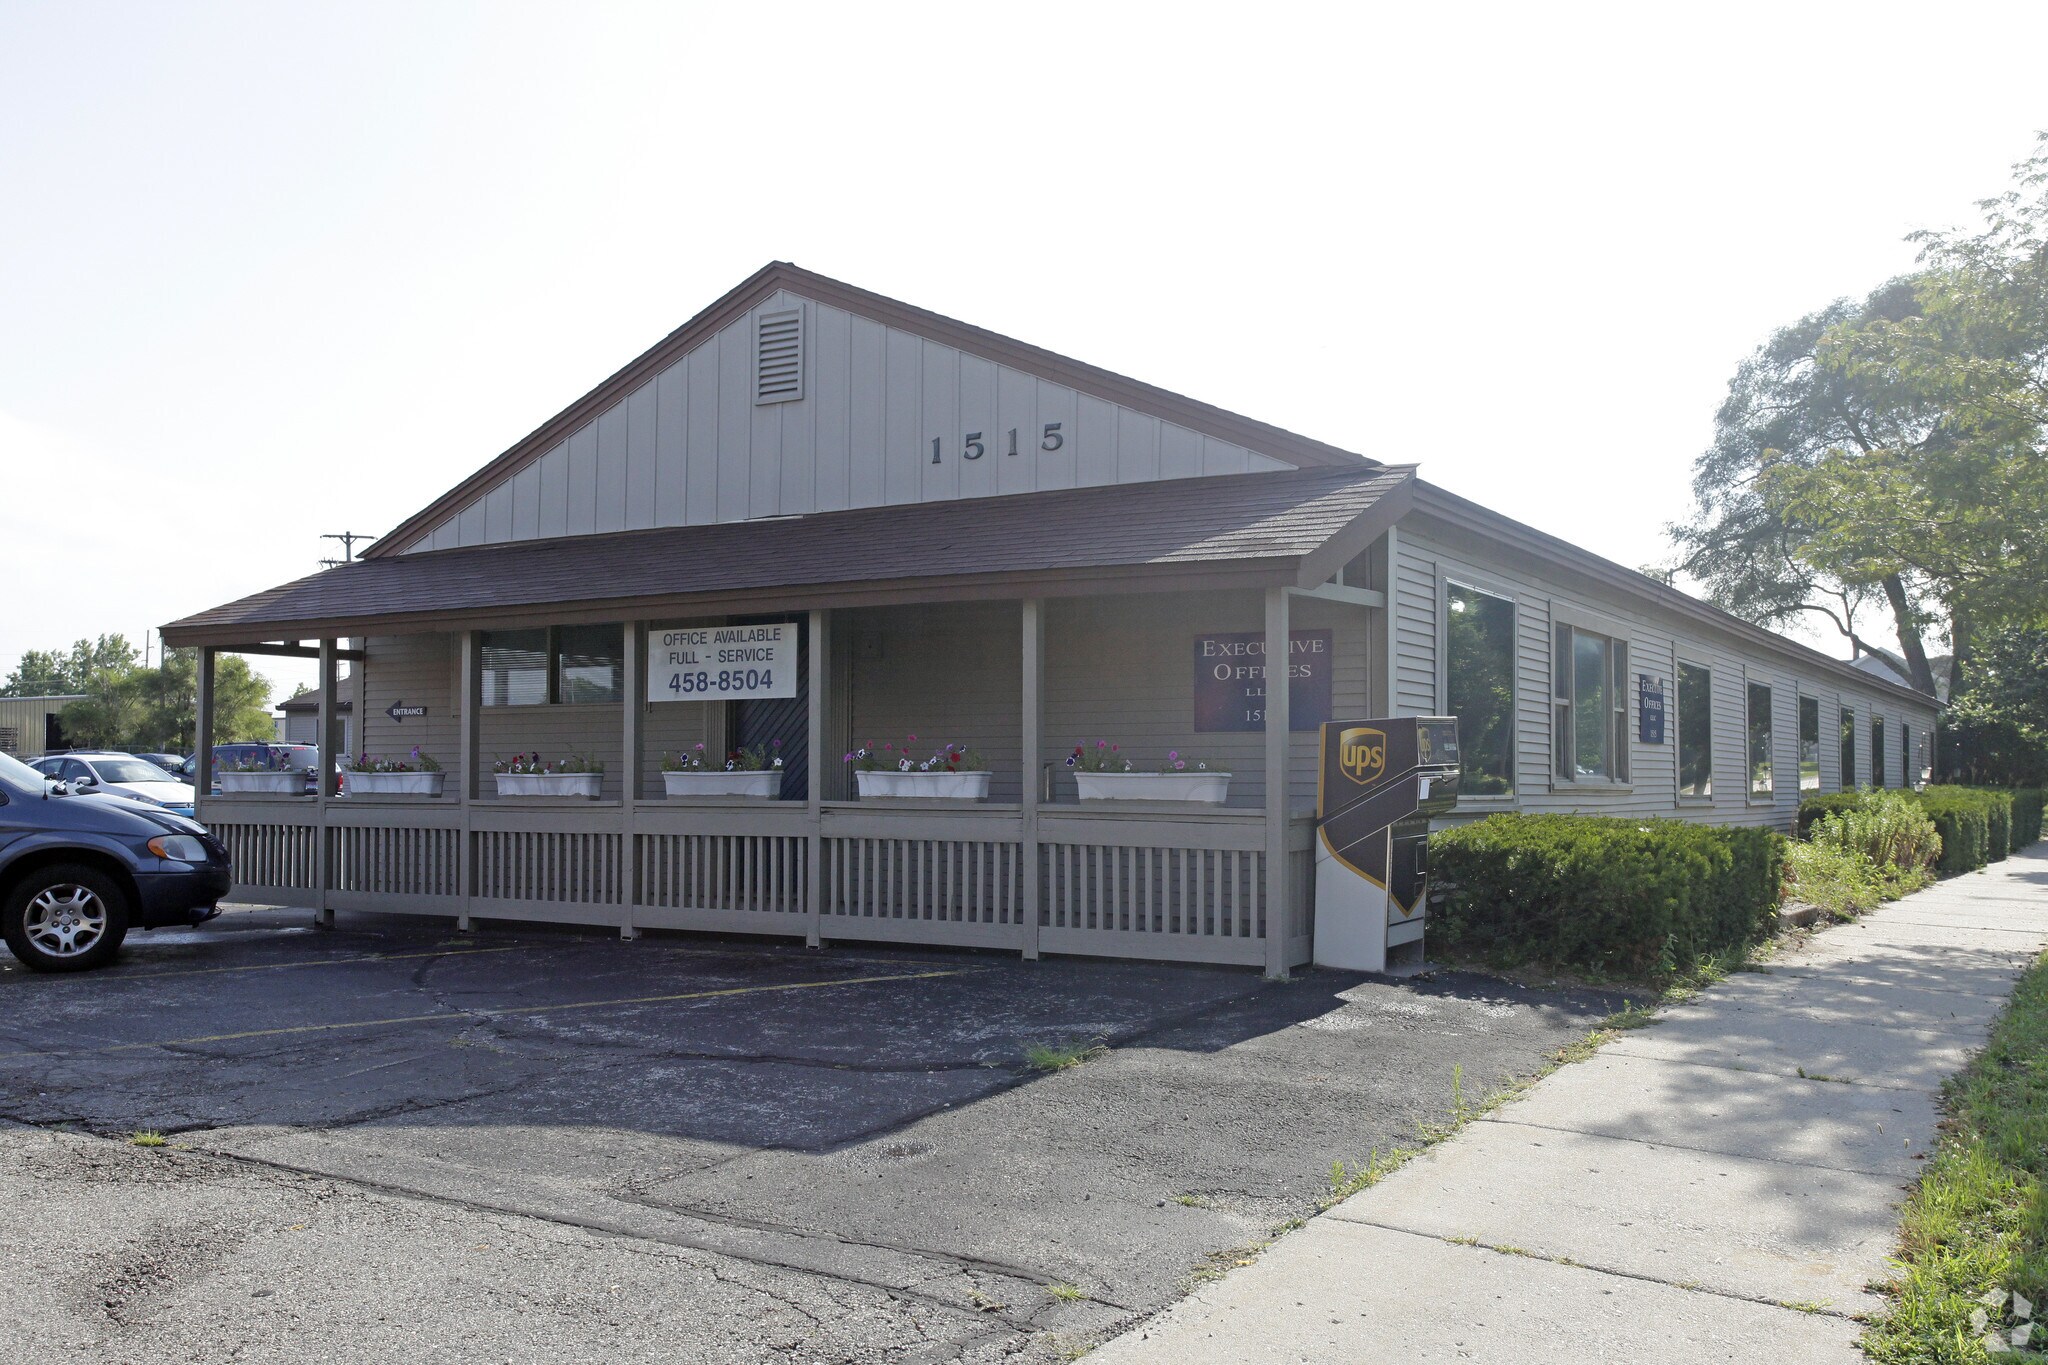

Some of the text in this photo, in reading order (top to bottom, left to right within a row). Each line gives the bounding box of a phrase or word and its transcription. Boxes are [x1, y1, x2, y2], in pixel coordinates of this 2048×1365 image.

[931, 422, 1064, 464] 1515
[663, 628, 782, 647] OFFICE AVAILABLE
[669, 652, 699, 665] FULL
[718, 648, 774, 663] SERVICE
[1202, 639, 1324, 657] EXECIVE
[668, 669, 773, 693] 458-8504
[1213, 663, 1312, 681] OFFIES
[393, 707, 423, 716] ENTRANCE
